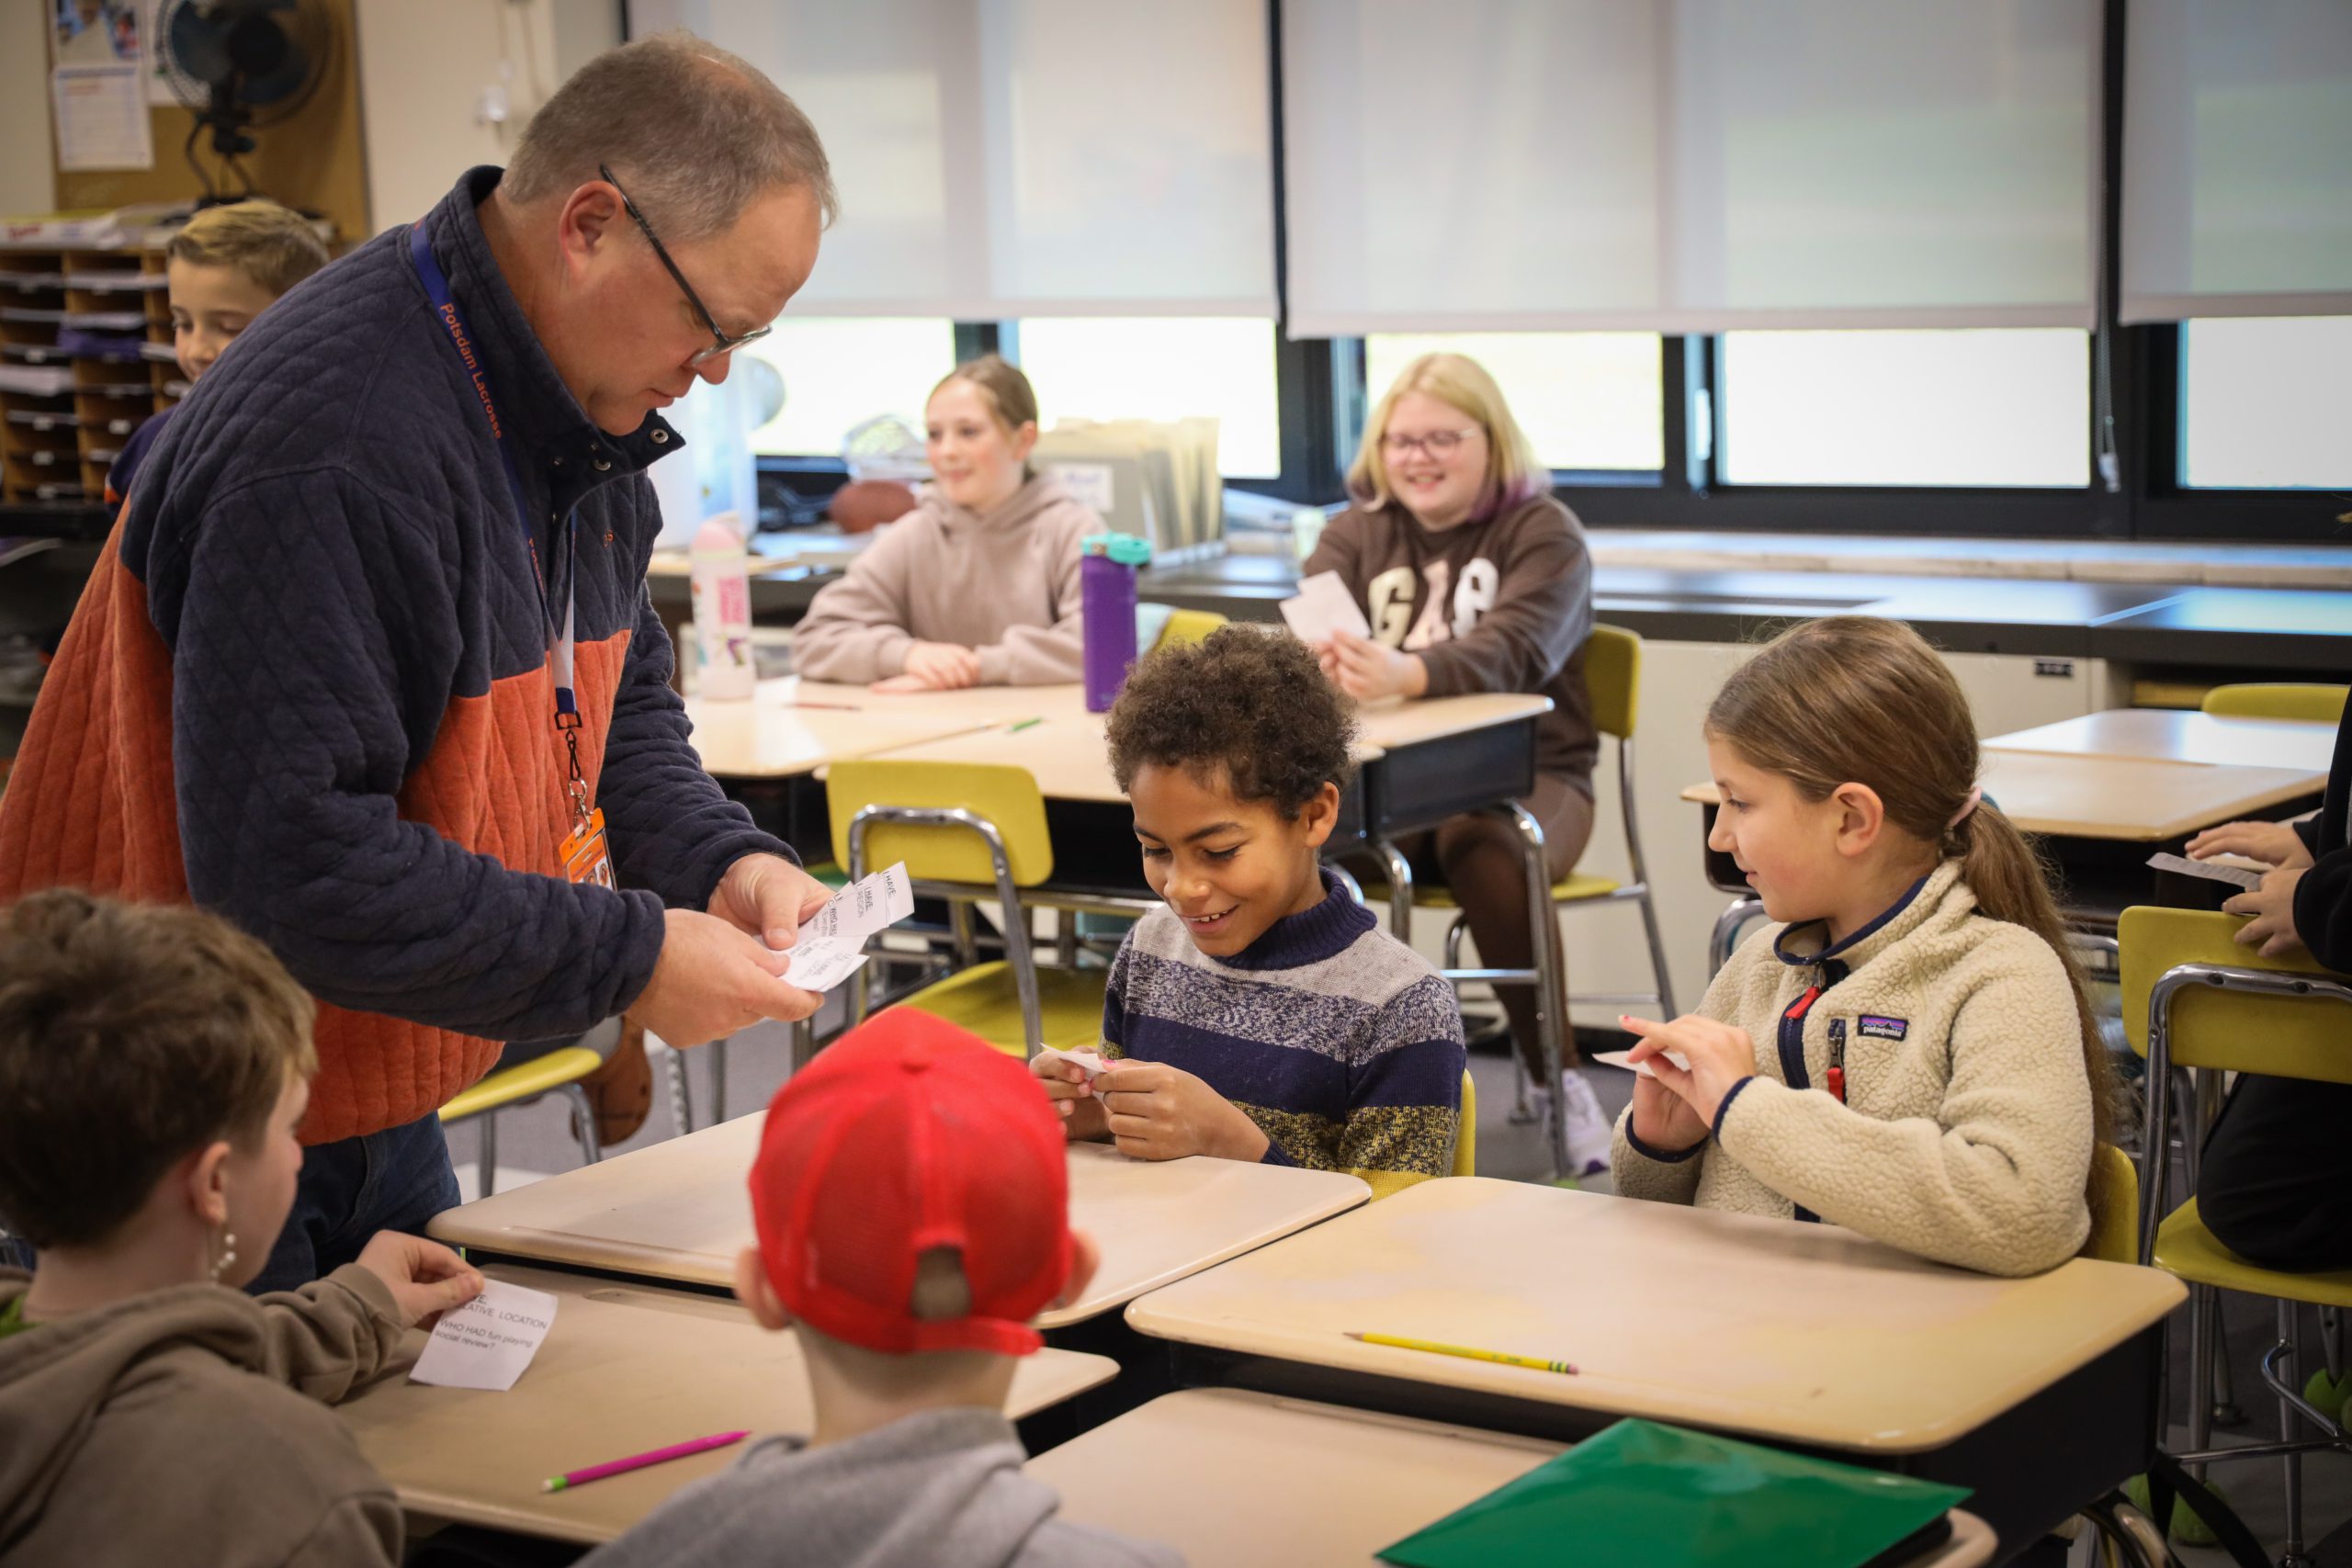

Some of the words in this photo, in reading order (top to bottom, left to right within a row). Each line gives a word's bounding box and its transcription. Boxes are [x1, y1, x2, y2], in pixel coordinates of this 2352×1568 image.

[440, 302, 478, 369] Potsdam
[471, 370, 502, 439] Lacrosse
[1863, 1026, 1902, 1037] patagonia
[499, 1311, 548, 1329] LOCATION
[435, 1329, 460, 1343] social
[439, 1318, 464, 1332] WHO
[466, 1325, 486, 1338] HAD
[488, 1331, 502, 1341] fun
[503, 1337, 533, 1348] playing
